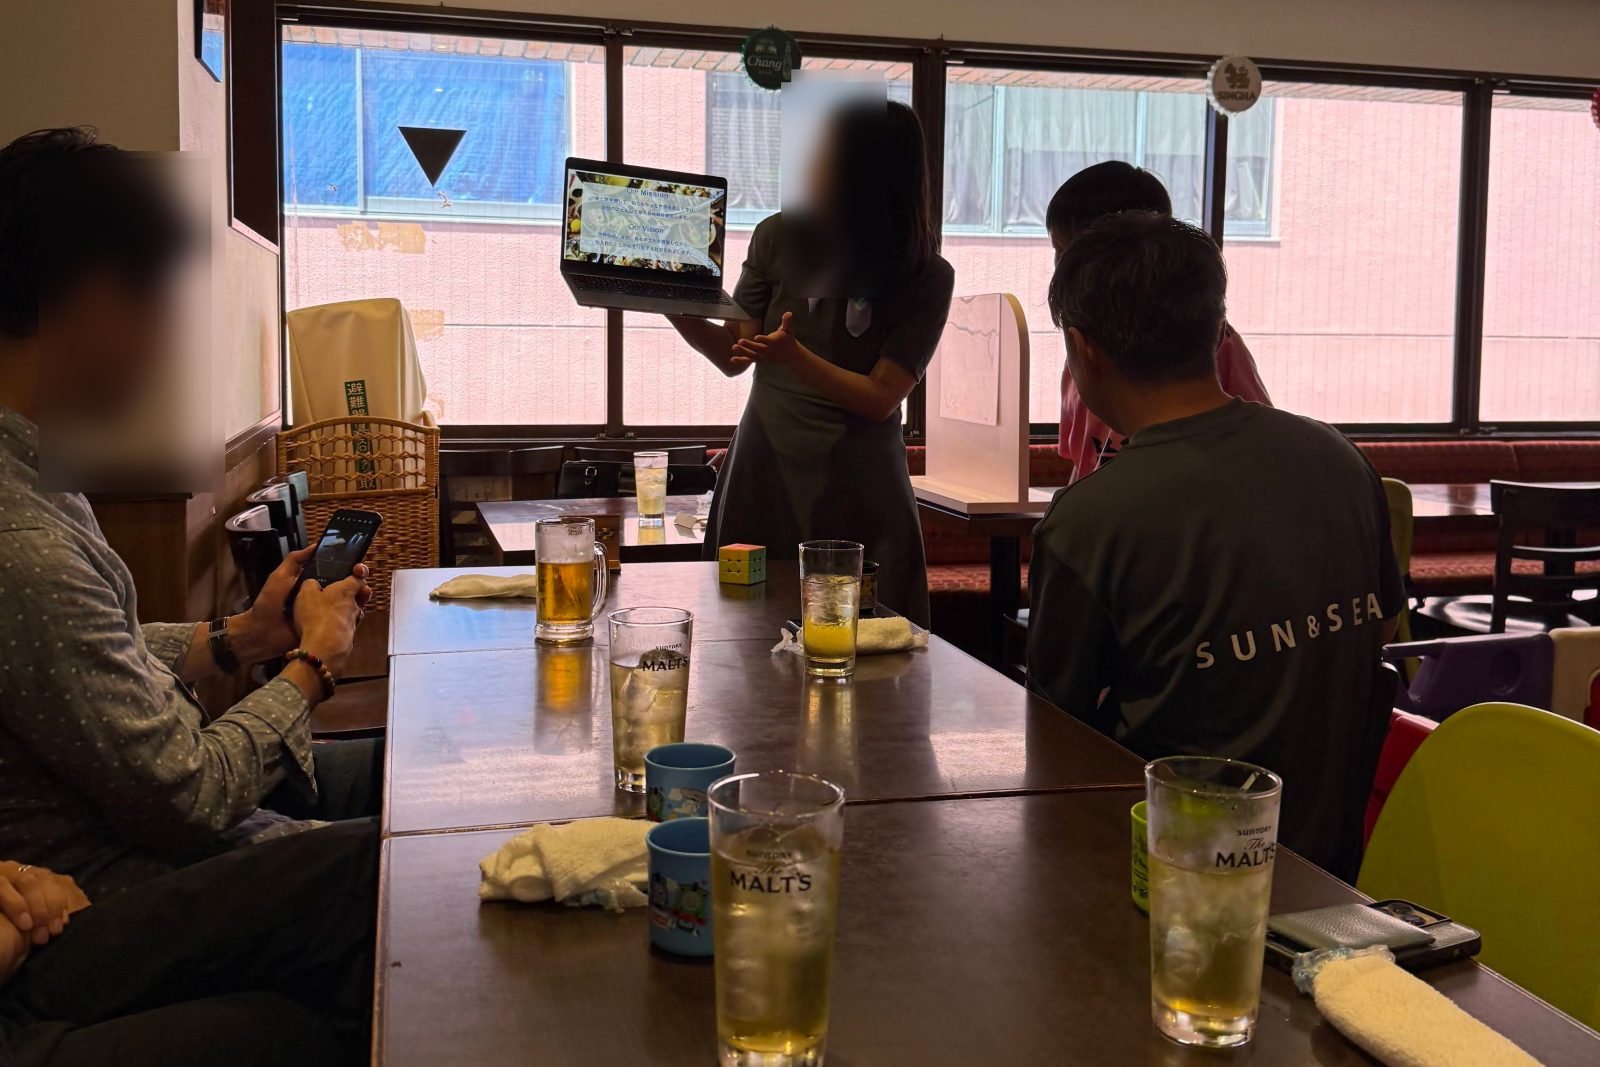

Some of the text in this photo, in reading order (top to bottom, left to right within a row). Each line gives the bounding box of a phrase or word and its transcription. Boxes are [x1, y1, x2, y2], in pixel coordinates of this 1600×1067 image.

[747, 54, 783, 71] Chang
[1217, 91, 1256, 101] SINGHA
[640, 189, 669, 199] Mission
[642, 224, 664, 234] Vision
[642, 655, 688, 672] MALT'S
[730, 871, 812, 893] MALT'S
